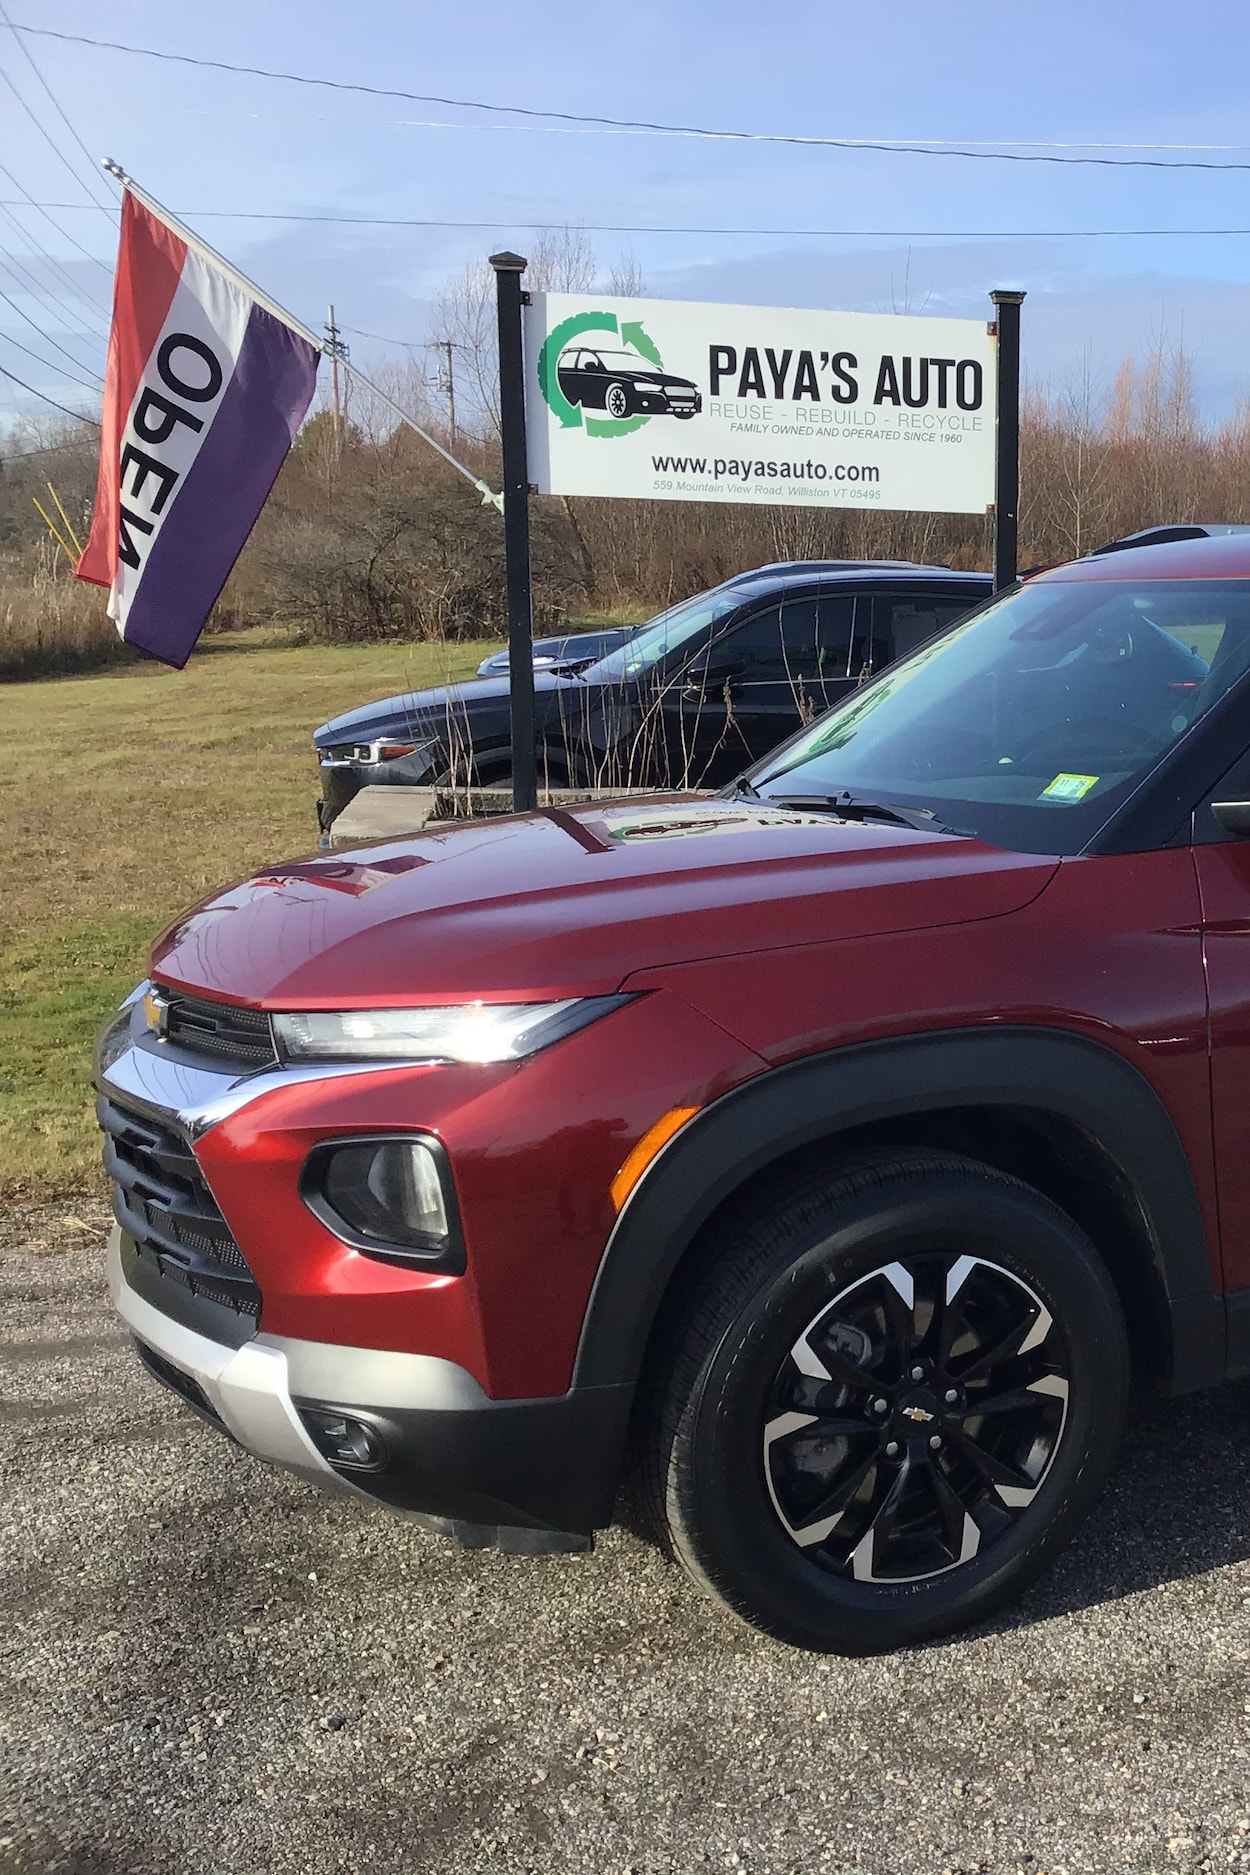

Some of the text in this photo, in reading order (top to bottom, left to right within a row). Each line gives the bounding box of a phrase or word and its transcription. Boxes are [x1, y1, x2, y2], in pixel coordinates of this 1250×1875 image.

[709, 344, 983, 411] PAYA'S AUTO
[709, 402, 773, 420] REUSE
[796, 407, 876, 426] REBUILD
[898, 413, 983, 431] RECYCLE
[730, 422, 963, 444] FAMILY OWNED AND OPERATED SINCE 1960
[651, 455, 880, 482] www.payasauto.com
[653, 480, 673, 490] 559
[675, 481, 724, 493] Mountain
[726, 483, 752, 494] View
[788, 486, 830, 498] Williston
[833, 488, 848, 498] VT
[849, 488, 881, 500] 05495
